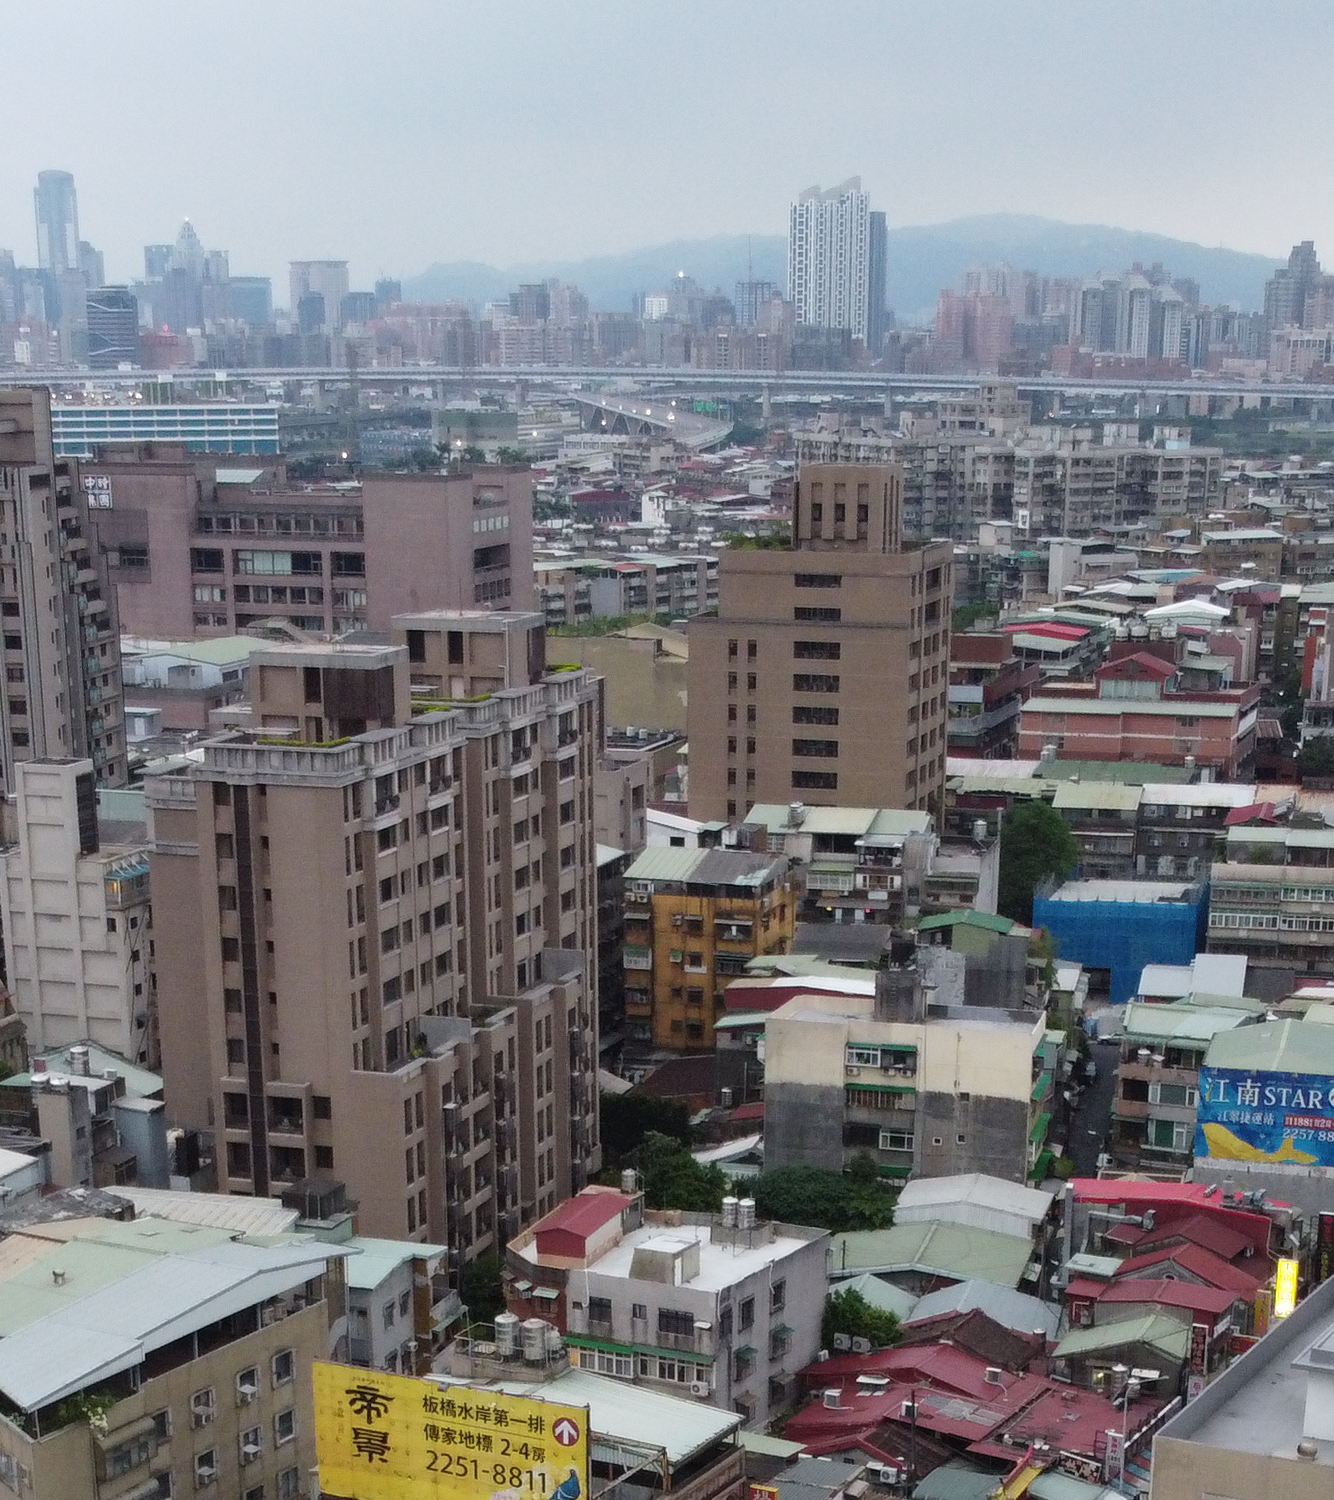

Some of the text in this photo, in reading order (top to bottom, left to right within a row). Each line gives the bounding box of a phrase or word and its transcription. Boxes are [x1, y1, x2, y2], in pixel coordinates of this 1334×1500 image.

[345, 1385, 395, 1463] 帝景
[422, 1394, 546, 1436] 板橋水岸第一排
[423, 1423, 546, 1464] 傳家地標 2-4房
[425, 1450, 547, 1494] 2251-8811
